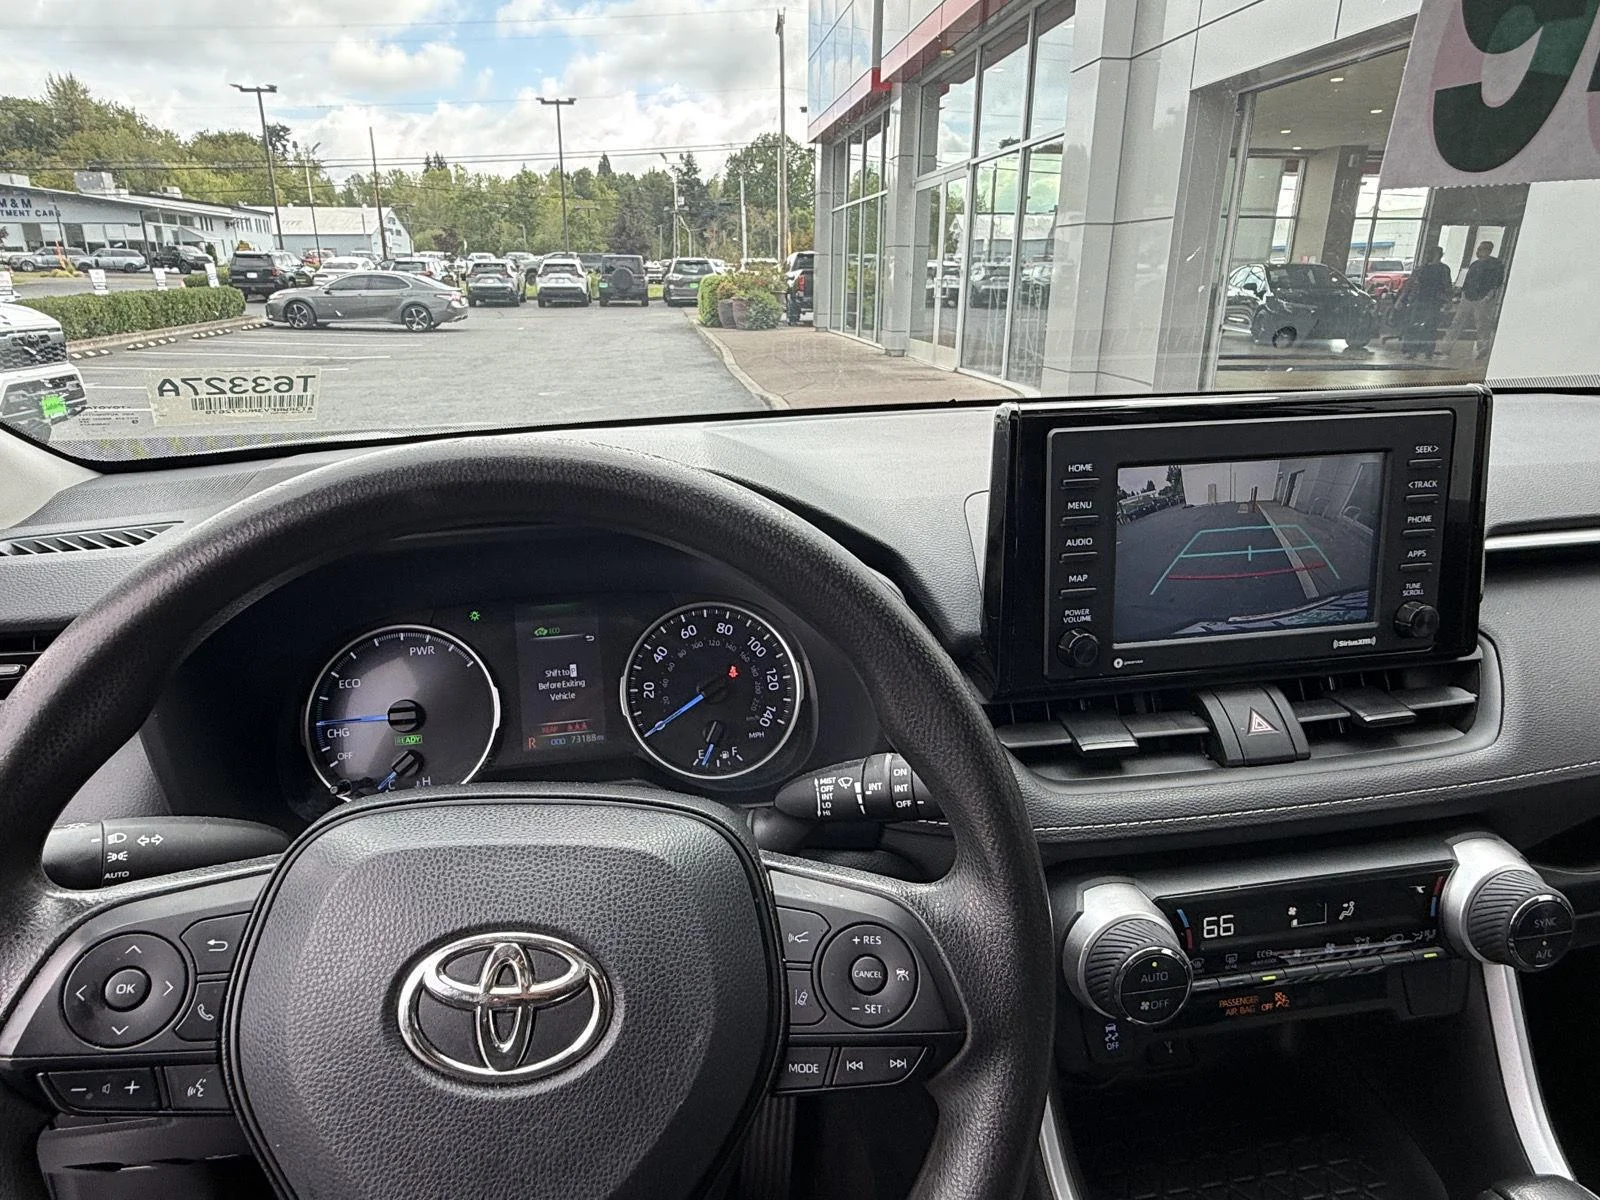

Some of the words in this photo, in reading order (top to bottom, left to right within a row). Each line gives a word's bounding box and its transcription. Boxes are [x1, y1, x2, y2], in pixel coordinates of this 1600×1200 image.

[10, 199, 19, 208] &
[22, 198, 32, 209] M
[35, 209, 62, 217] CARS
[1068, 464, 1093, 473] HOME
[1414, 480, 1438, 489] TRACK
[1067, 501, 1093, 510] MENU
[1407, 515, 1433, 524] PHONE
[1066, 538, 1093, 547] AUDIO
[1407, 550, 1427, 558] APPS
[1068, 574, 1088, 583] MAP
[1402, 588, 1424, 597] SCROLL
[1063, 615, 1092, 623] VOLUME
[680, 624, 697, 639] 60
[716, 622, 734, 636] 80
[708, 639, 721, 647] 120
[746, 636, 767, 658] 100
[409, 646, 435, 656] PWR
[652, 646, 668, 664] 40
[338, 678, 361, 689] ECO
[538, 681, 561, 690] Before
[562, 679, 586, 688] Exiting
[765, 668, 780, 691] 120
[643, 681, 655, 699] 20
[550, 692, 576, 701] Vehicle
[759, 705, 777, 728] 140
[327, 727, 350, 738] CHG
[748, 731, 765, 739] MPH
[528, 737, 537, 749] R
[337, 751, 353, 761] OFF
[698, 750, 704, 759] E
[731, 746, 738, 756] F
[893, 768, 908, 776] ON
[422, 775, 431, 787] H
[819, 777, 837, 785] MIST
[820, 785, 834, 793] OFF
[868, 782, 883, 791] INT
[894, 783, 908, 792] INT
[821, 793, 834, 801] INT
[895, 799, 912, 808] OFF
[104, 870, 130, 880] AUTO
[1203, 914, 1234, 937] 66
[1534, 917, 1556, 928] SYNC
[1535, 950, 1552, 960] A/C
[853, 970, 883, 979] CANCEL
[1140, 971, 1169, 984] AUTO
[115, 983, 136, 995] OK
[1151, 999, 1170, 1011] OFF
[1218, 996, 1259, 1008] PASSENGER
[1225, 1007, 1238, 1017] AIR
[1261, 1003, 1274, 1012] OFF
[1106, 1042, 1120, 1051] OFF
[788, 1063, 819, 1074] MODE
